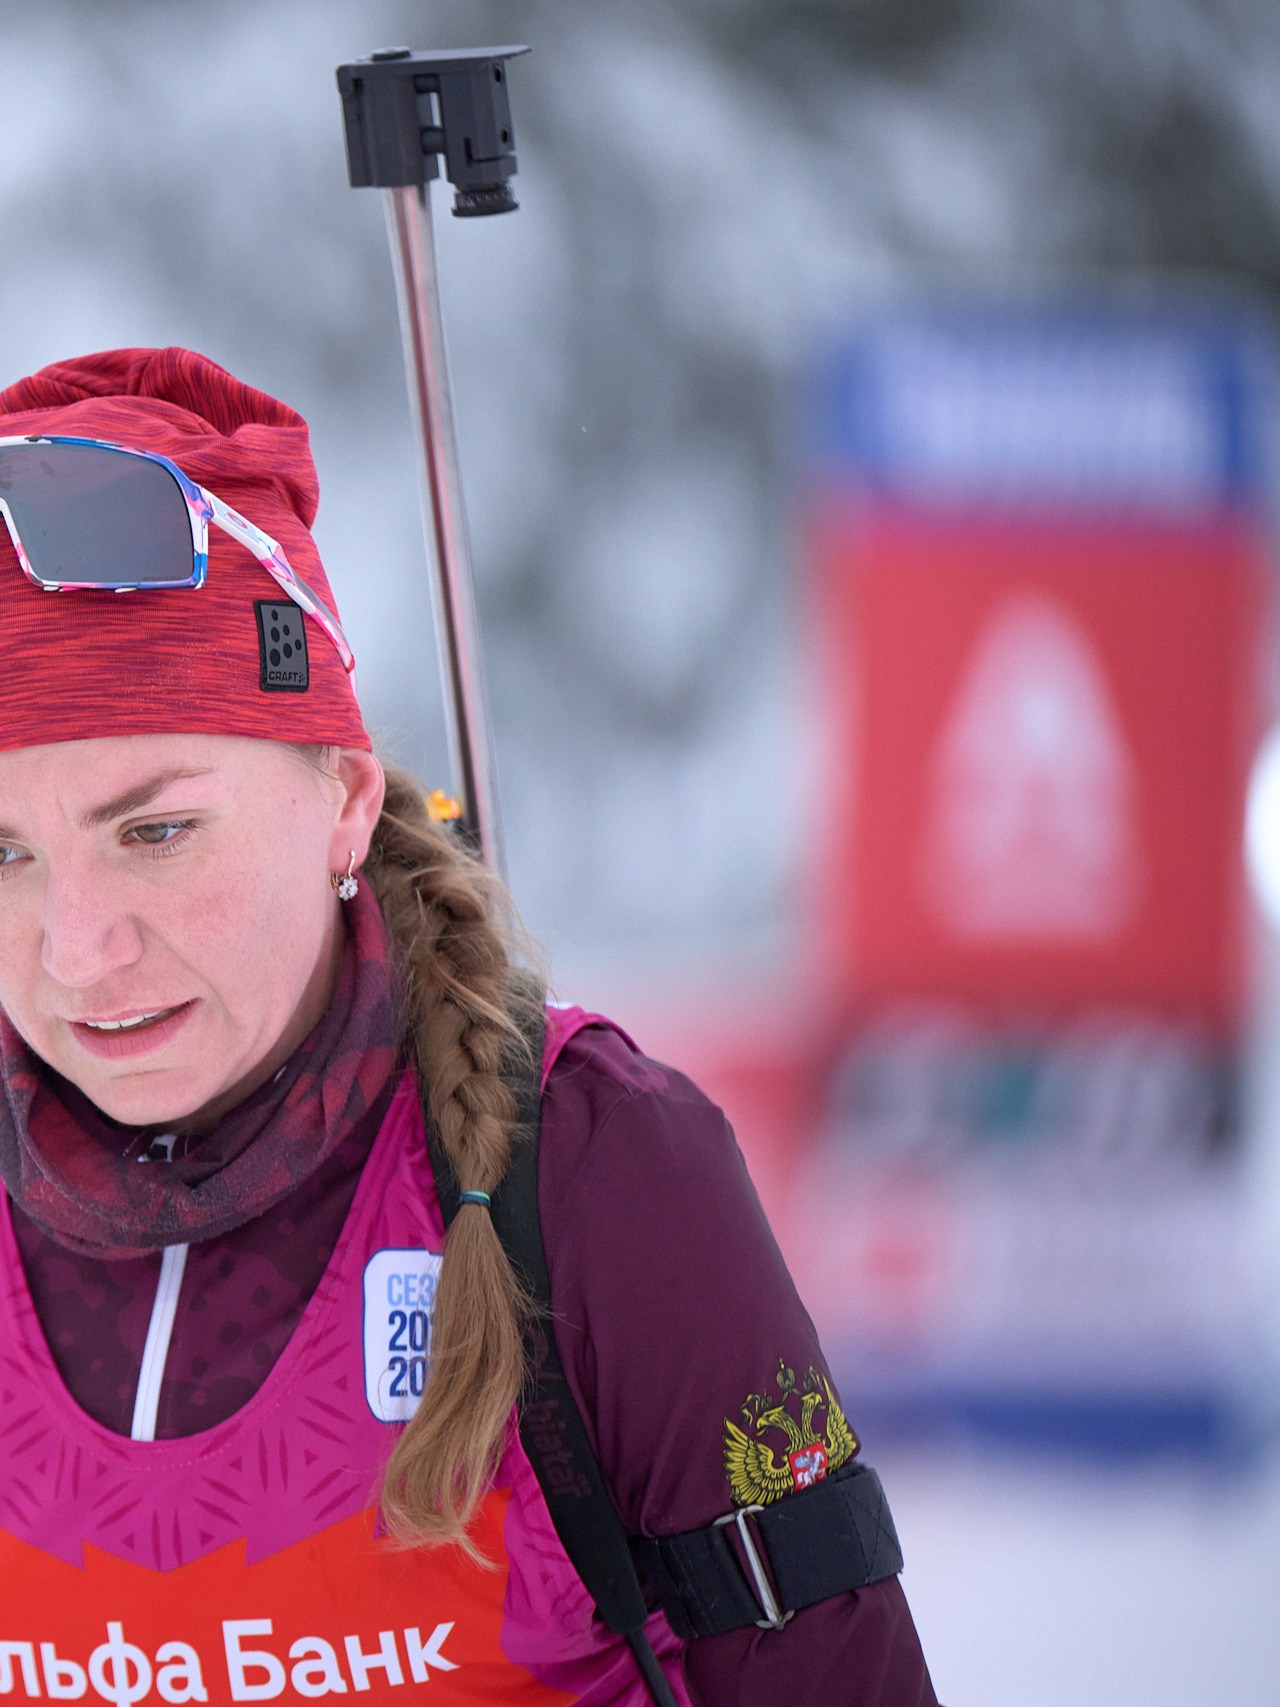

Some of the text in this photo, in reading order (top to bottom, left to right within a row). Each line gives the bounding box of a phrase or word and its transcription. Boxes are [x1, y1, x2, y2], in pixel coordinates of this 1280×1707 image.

[268, 671, 298, 682] CRAFT
[387, 1273, 438, 1307] СЕЗ
[388, 1310, 434, 1352] 20
[389, 1356, 428, 1398] 20
[222, 1618, 460, 1702] Банк
